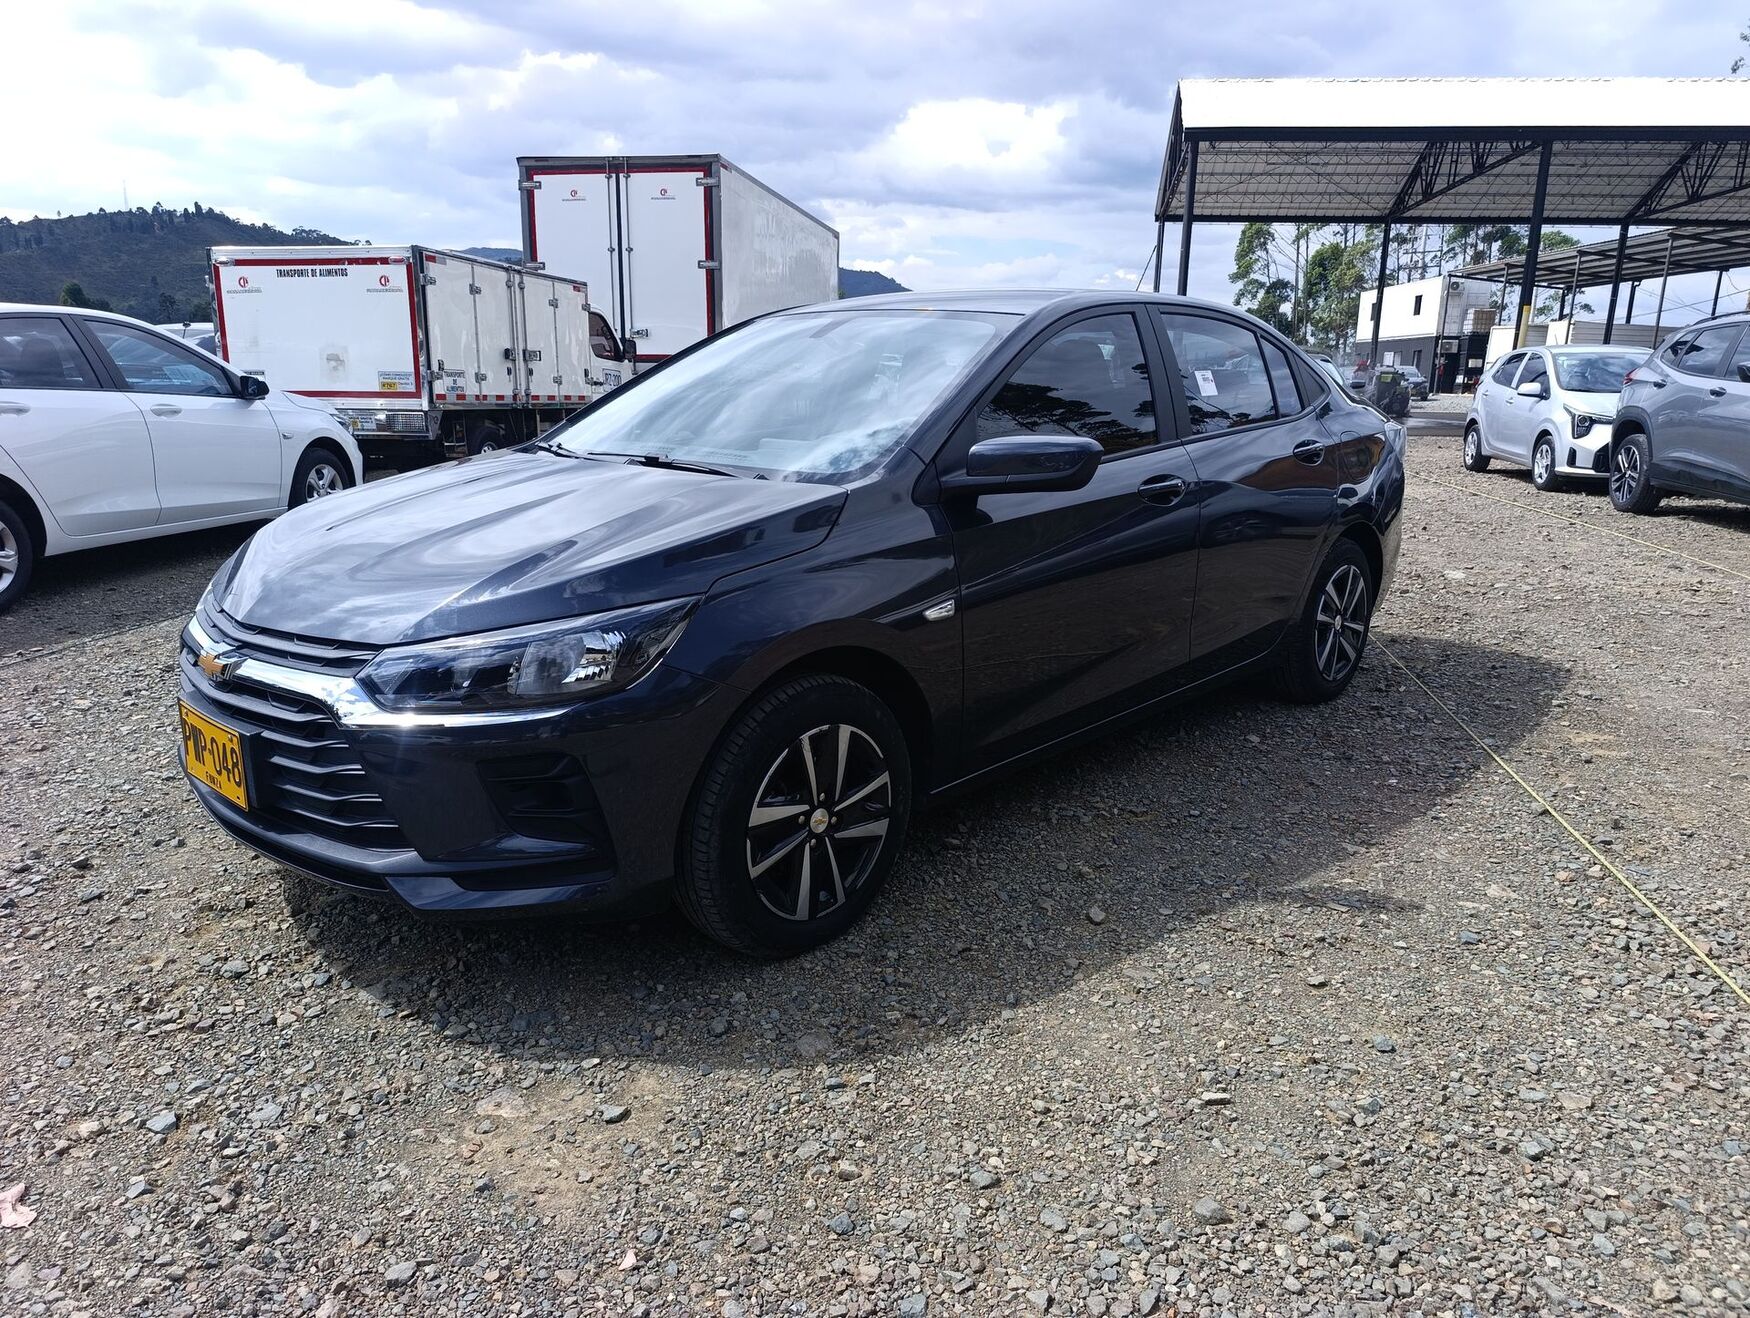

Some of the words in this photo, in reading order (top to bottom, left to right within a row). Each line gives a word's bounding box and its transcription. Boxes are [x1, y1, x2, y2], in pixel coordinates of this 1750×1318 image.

[276, 268, 310, 278] TRANSPORTE
[311, 268, 318, 278] DE
[319, 268, 349, 277] ALIMENTOS
